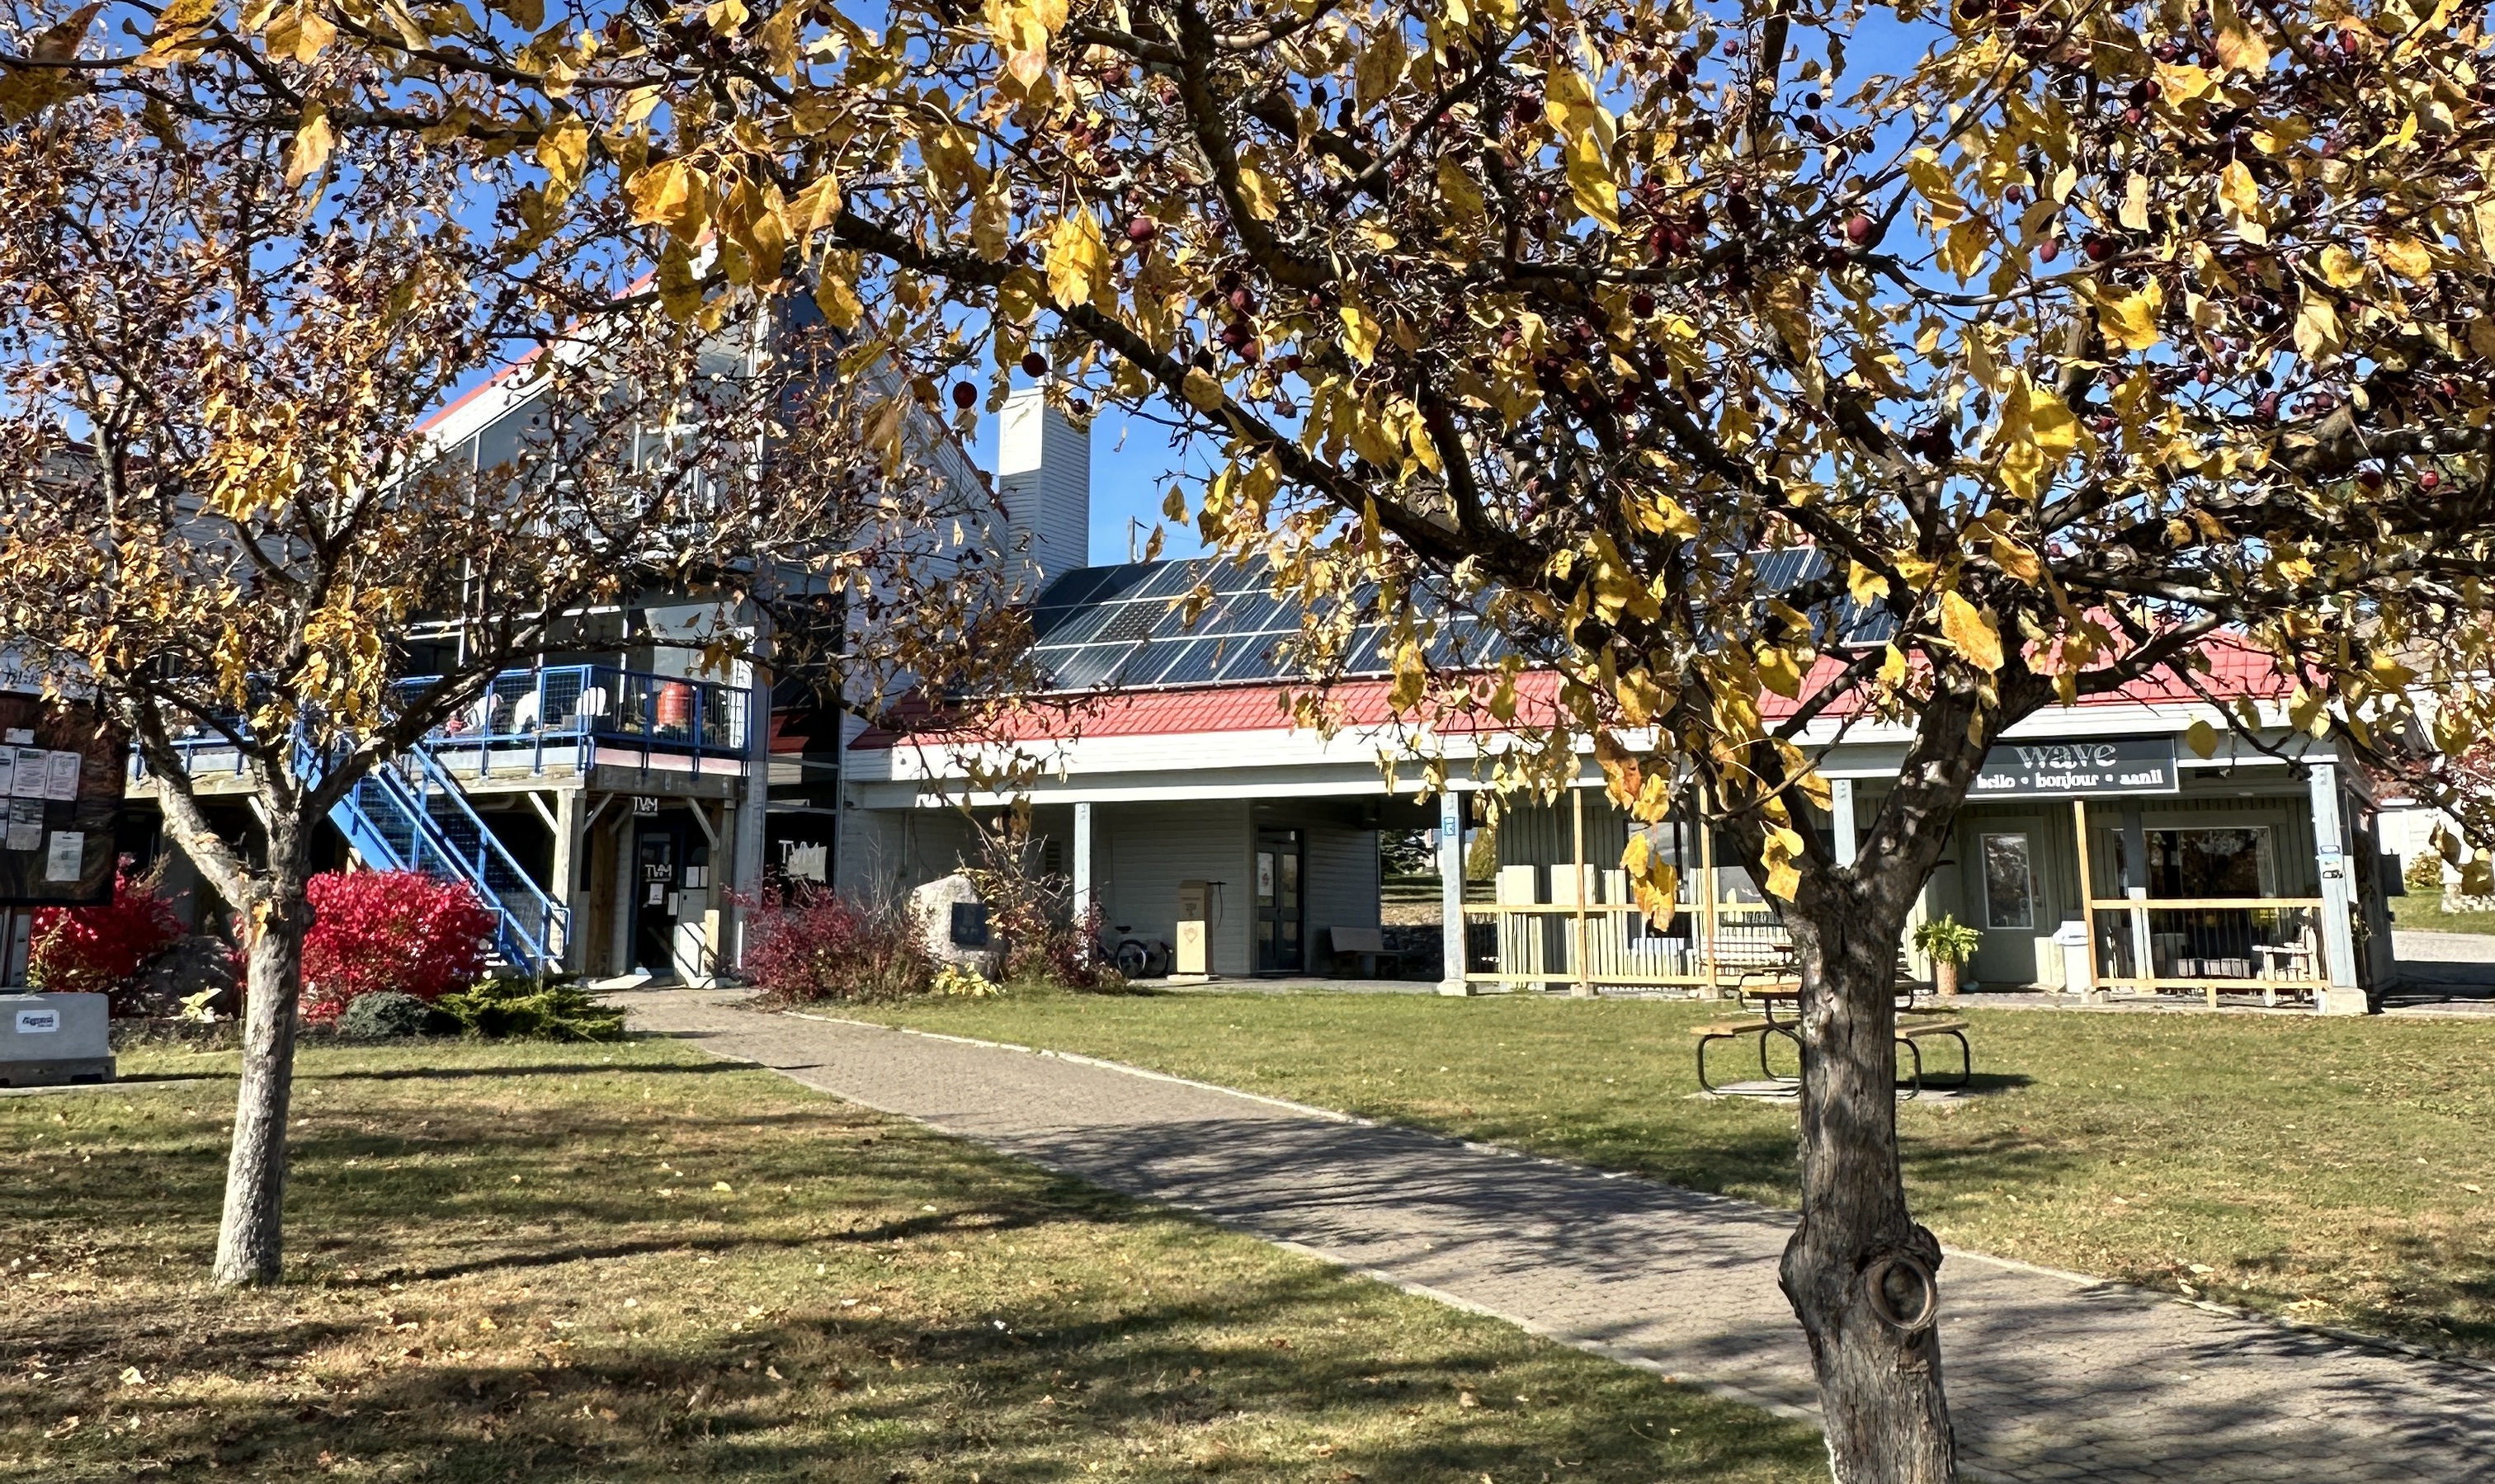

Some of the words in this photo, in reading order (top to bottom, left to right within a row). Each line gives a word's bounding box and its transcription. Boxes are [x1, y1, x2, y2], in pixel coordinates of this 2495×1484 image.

[2013, 744, 2115, 769] wave
[1977, 773, 2015, 789] hello
[2035, 771, 2099, 789] bonjour
[633, 796, 658, 812] TVM
[778, 840, 819, 864] TVM
[645, 864, 672, 878] TVM
